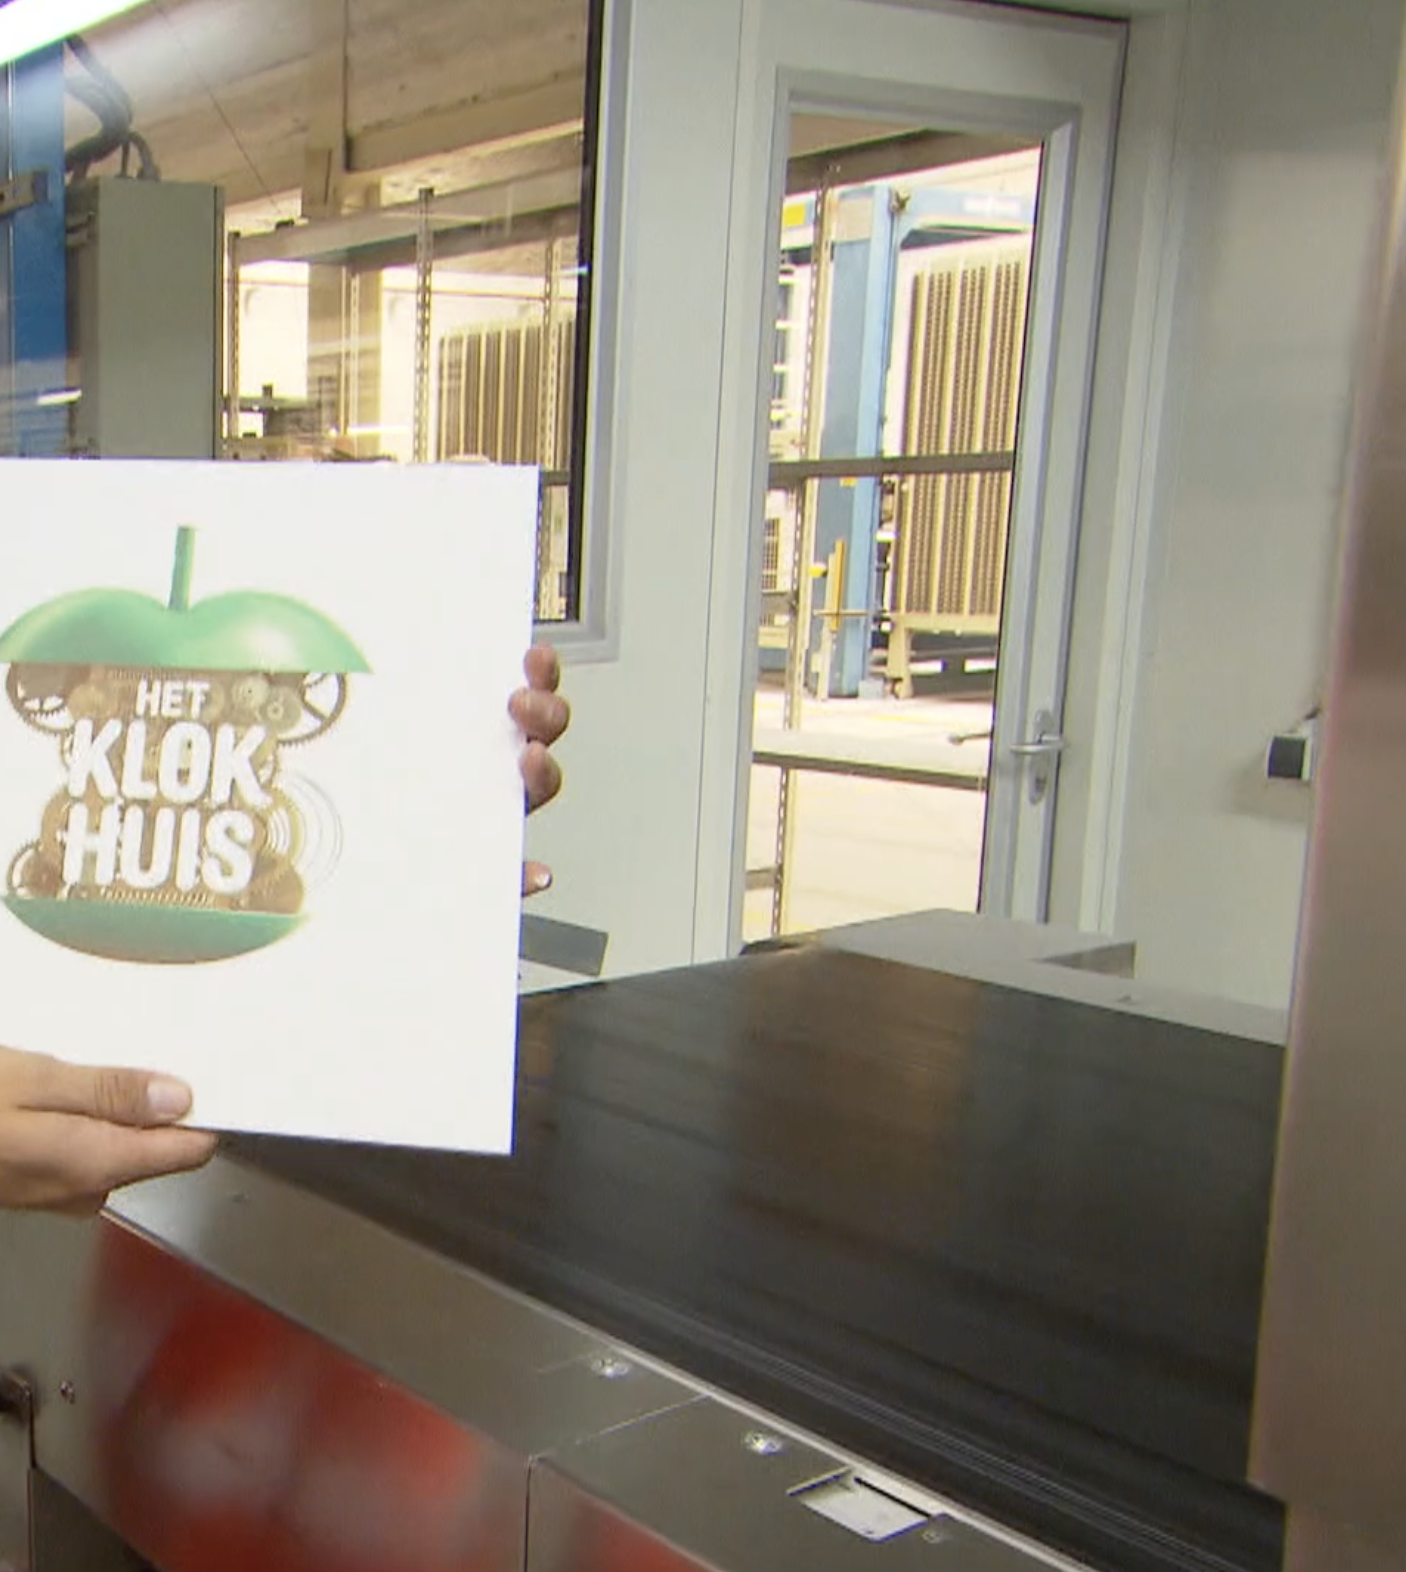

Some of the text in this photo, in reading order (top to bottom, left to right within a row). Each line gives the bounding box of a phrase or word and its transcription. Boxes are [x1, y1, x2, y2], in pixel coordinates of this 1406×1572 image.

[136, 678, 211, 718] HET
[67, 717, 272, 804] KLOK
[61, 803, 255, 893] HUIS
